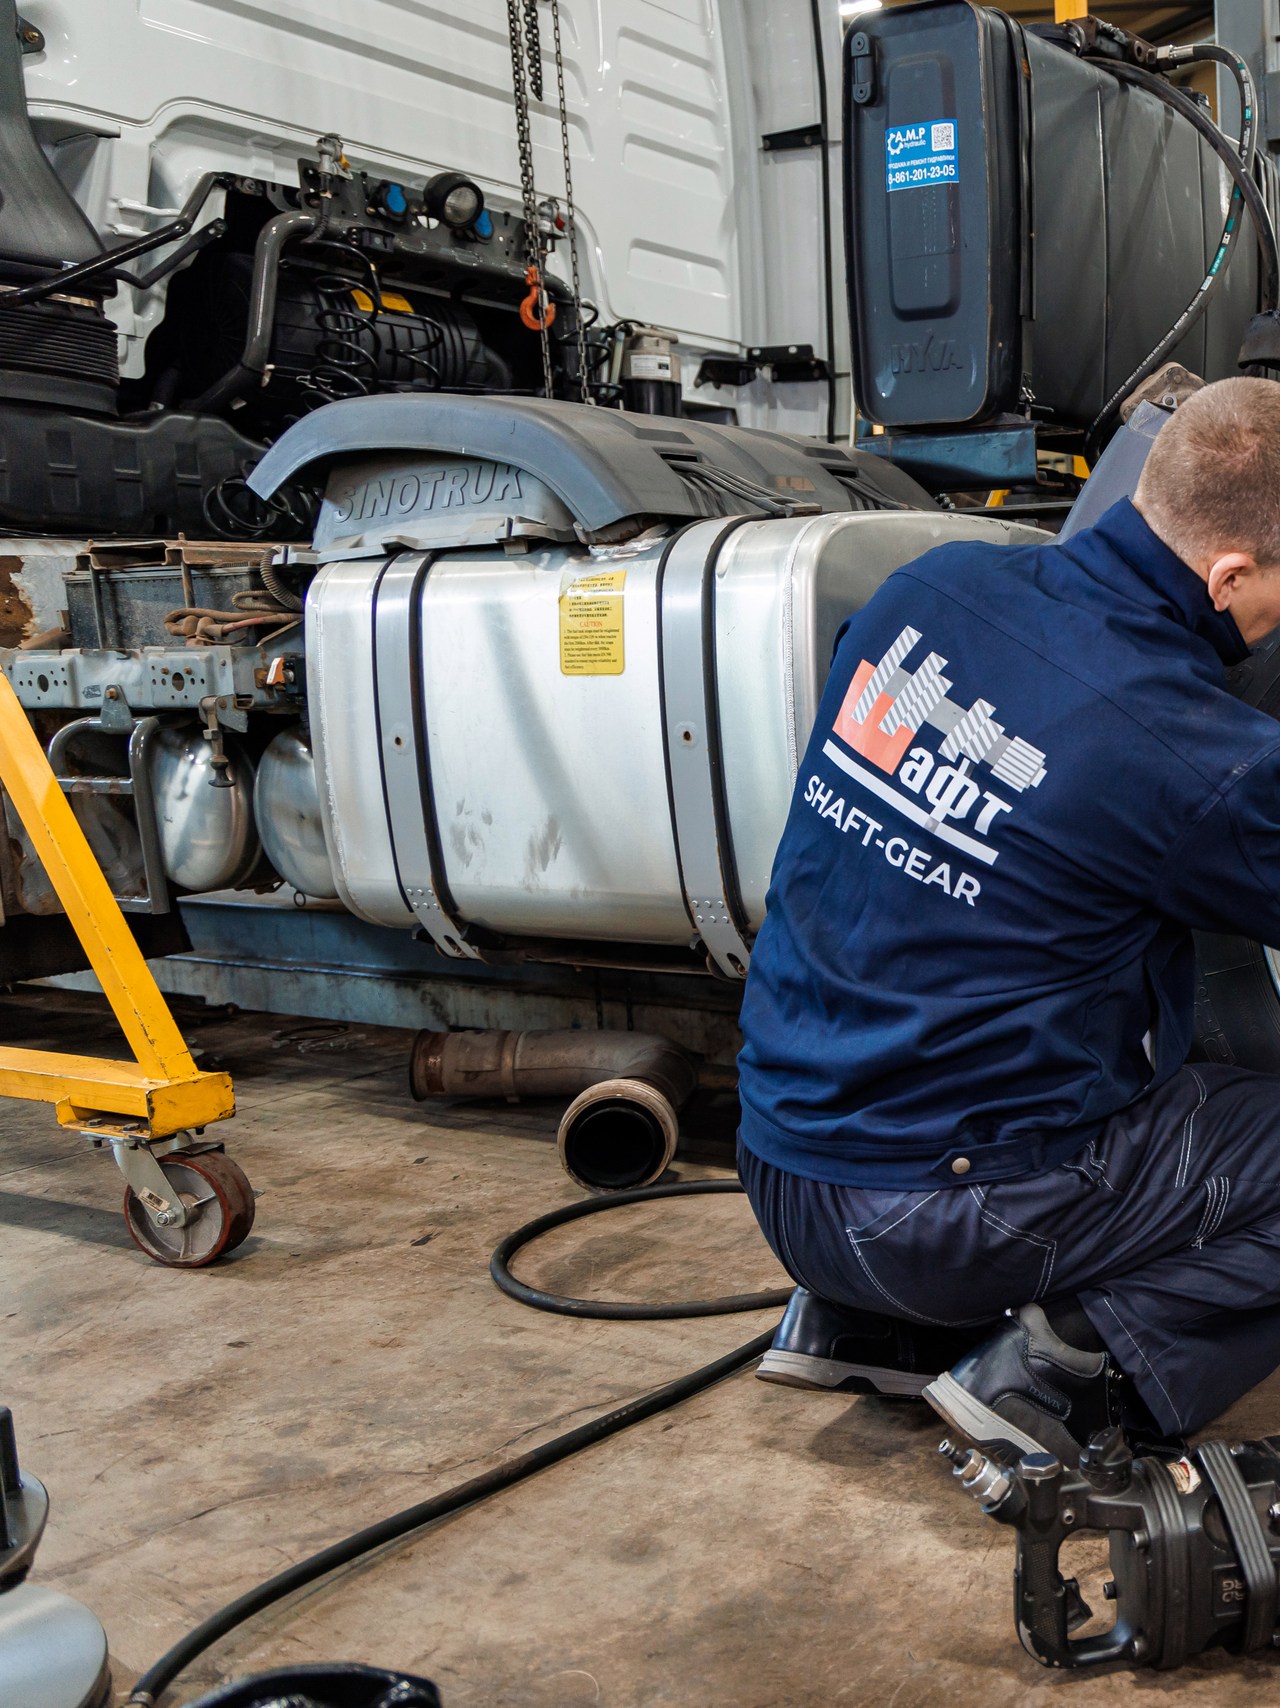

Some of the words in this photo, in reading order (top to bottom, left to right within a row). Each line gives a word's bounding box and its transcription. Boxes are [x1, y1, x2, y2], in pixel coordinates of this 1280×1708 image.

[888, 164, 955, 185] 8-861-201-23-05
[332, 463, 524, 523] SINOTRUK
[803, 774, 982, 907] SHAFT-GEAR
